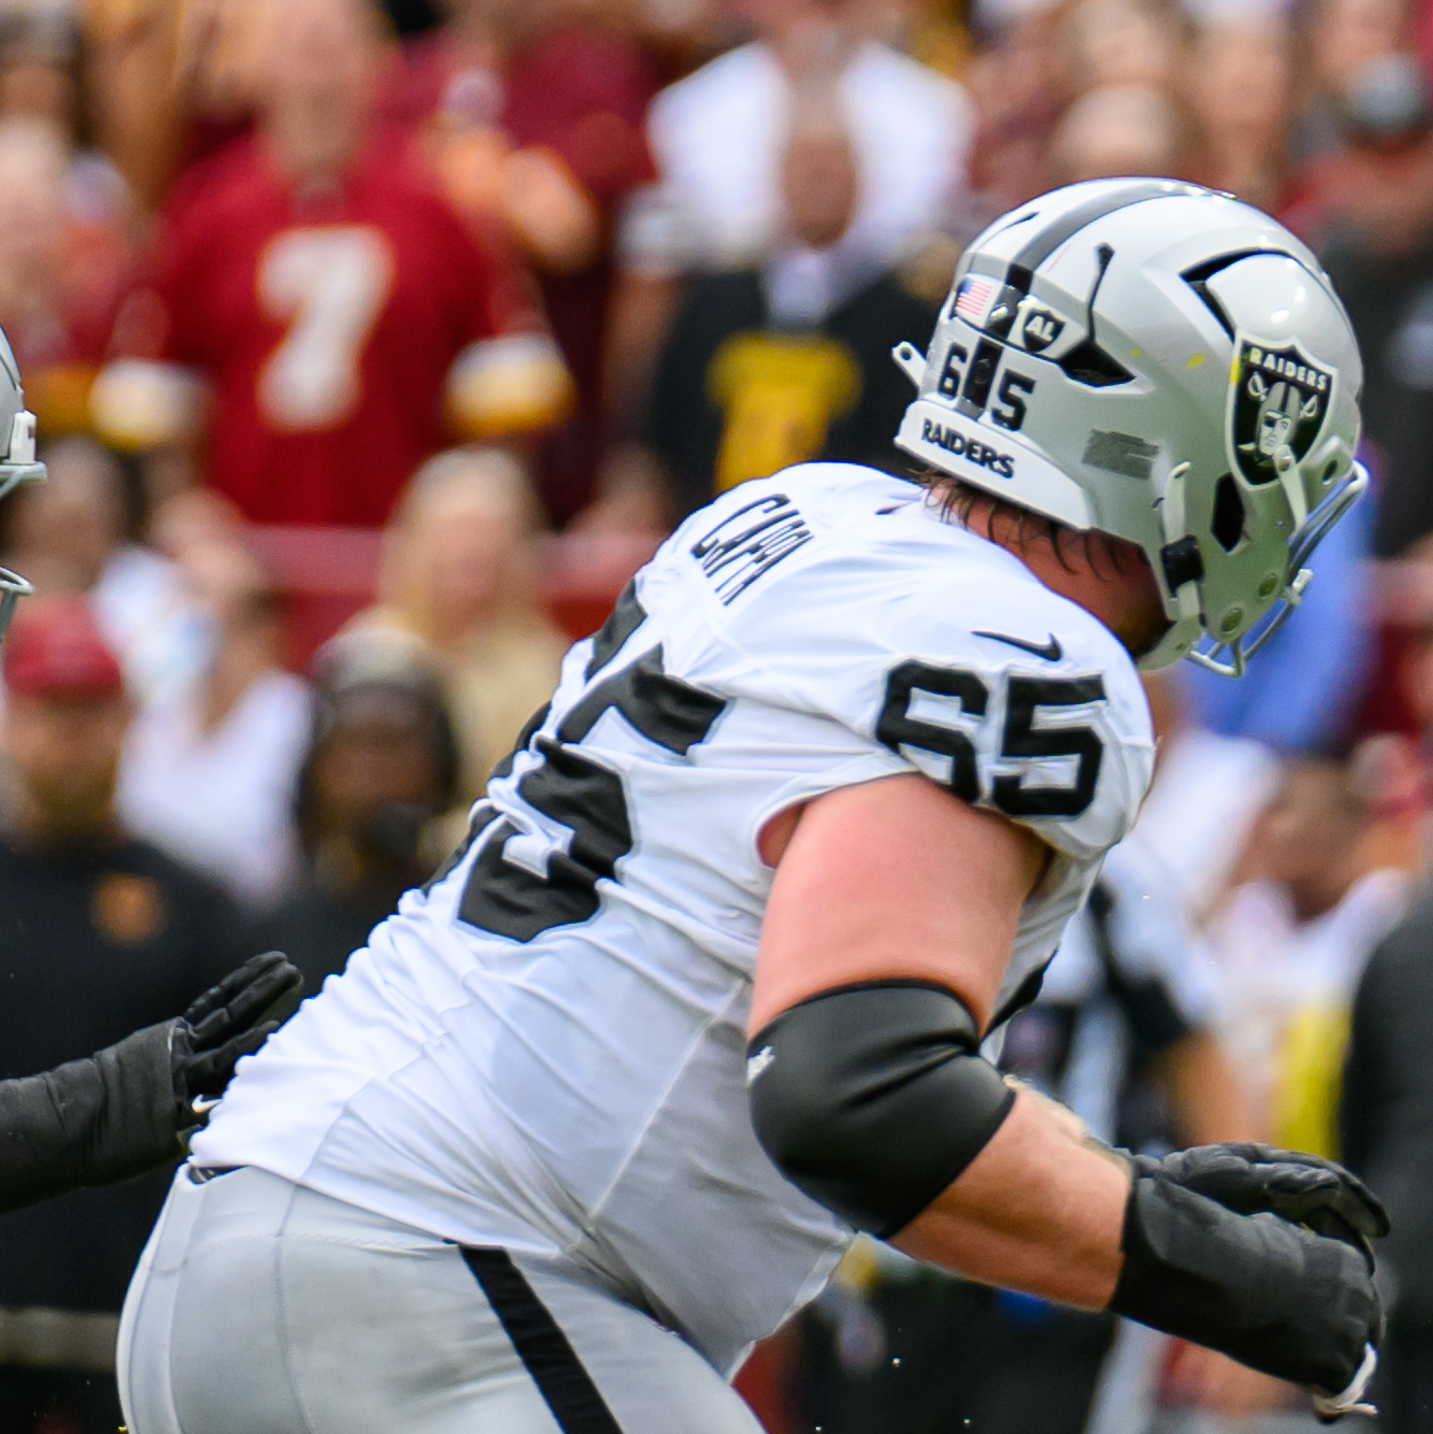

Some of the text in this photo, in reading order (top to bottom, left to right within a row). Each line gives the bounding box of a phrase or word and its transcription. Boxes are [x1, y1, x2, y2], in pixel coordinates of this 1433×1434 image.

[254, 223, 396, 431] 7
[1024, 314, 1056, 343] AL
[936, 341, 1037, 433] 65
[1249, 346, 1328, 391] RAIDERS
[921, 416, 1016, 479] RAIDERS
[875, 656, 1110, 816] 65
